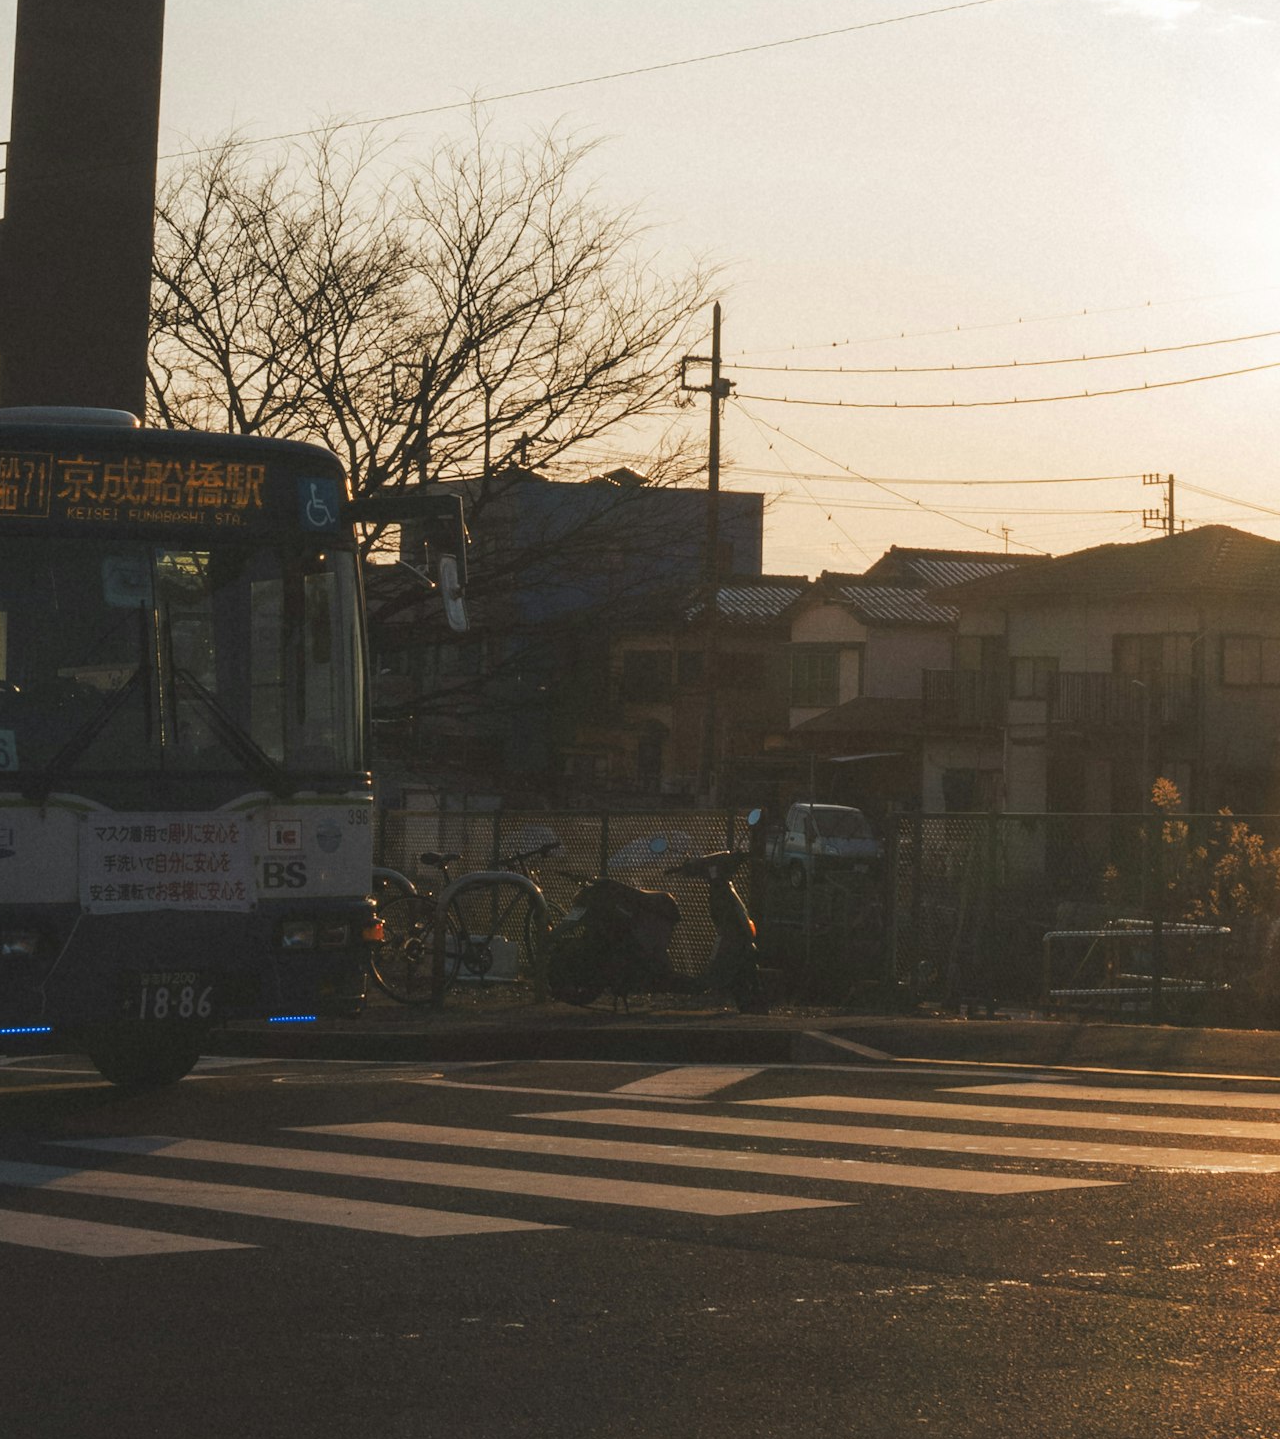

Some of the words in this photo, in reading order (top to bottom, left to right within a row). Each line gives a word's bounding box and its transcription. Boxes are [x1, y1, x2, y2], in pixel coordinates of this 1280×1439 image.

[57, 454, 266, 509] 京成船橋駅
[67, 507, 119, 522] KEISEI
[129, 509, 206, 525] FUNABASHI
[215, 512, 247, 526] STA.
[348, 809, 368, 825] 396
[95, 822, 240, 844] マスク着用で周りに安心を
[103, 854, 231, 874] 手洗いで自分に安心を
[263, 862, 307, 889] BS
[89, 881, 246, 902] 安全運転でお客様に安心を
[139, 986, 213, 1020] 18-86
